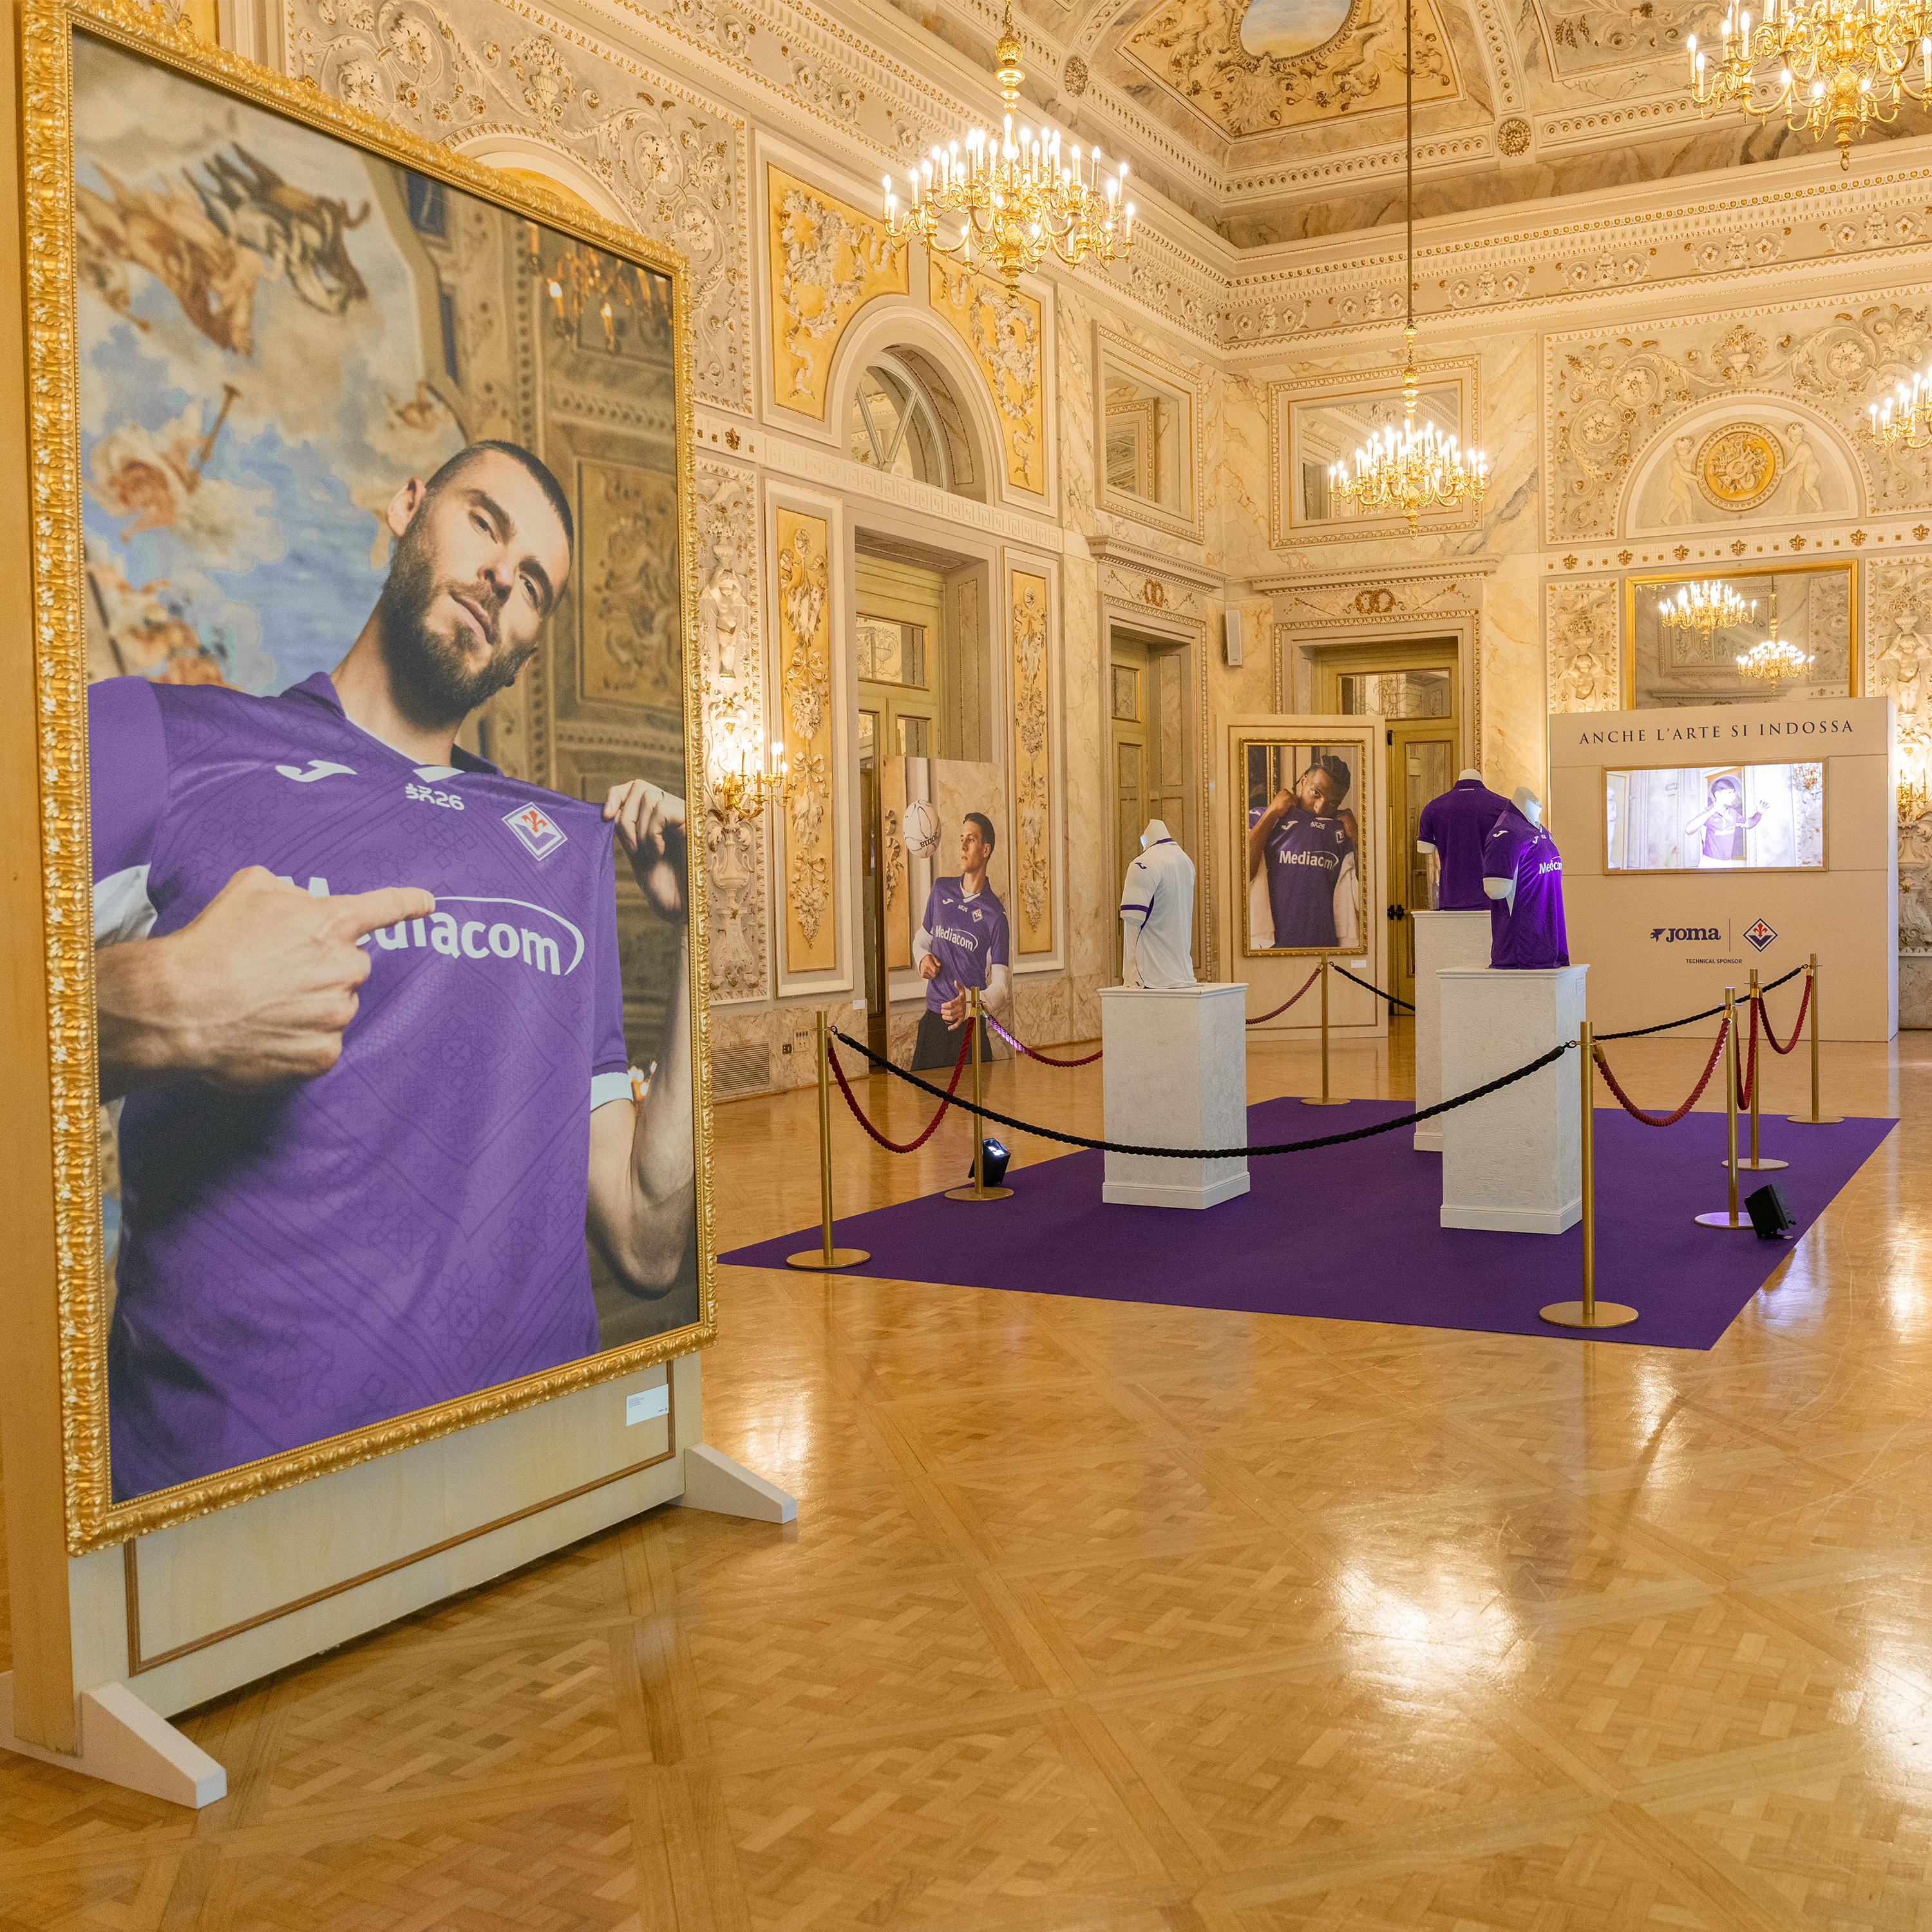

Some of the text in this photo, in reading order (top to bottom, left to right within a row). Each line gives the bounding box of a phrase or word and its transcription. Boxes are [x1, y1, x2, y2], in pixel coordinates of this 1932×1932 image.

[1579, 720, 1853, 744] ANCHE L'ARTE SI INDOSSA
[935, 925, 974, 952] Mediacom
